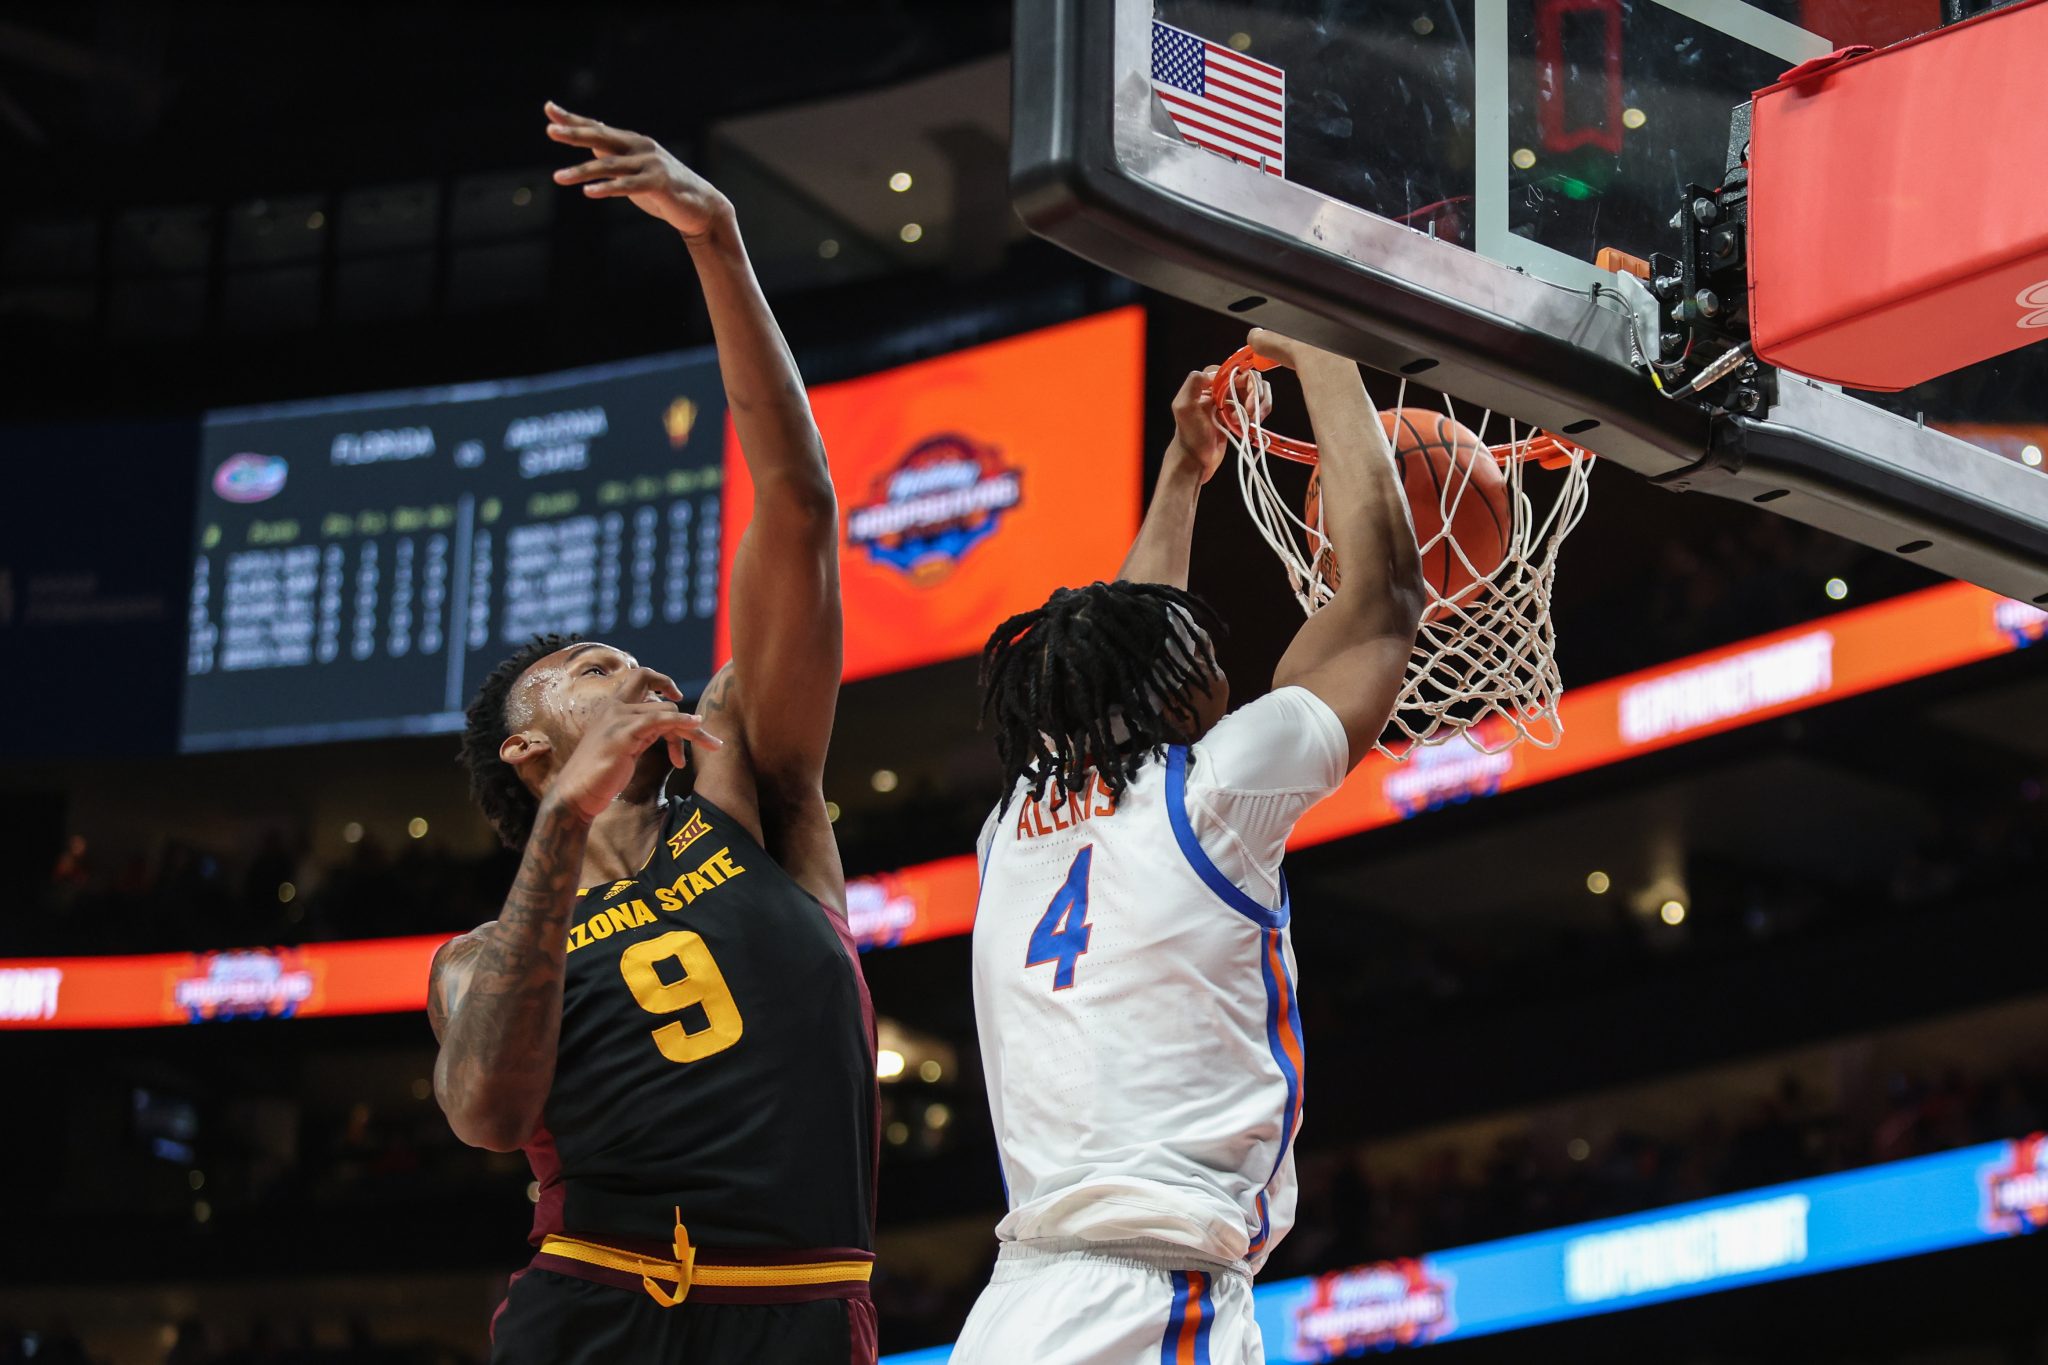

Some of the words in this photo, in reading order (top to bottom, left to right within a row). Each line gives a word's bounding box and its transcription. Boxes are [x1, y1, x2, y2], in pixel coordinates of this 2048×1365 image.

[331, 425, 435, 466] FLORIDA
[655, 846, 746, 912] STATE
[1025, 843, 1093, 992] 4
[620, 930, 743, 1063] 9
